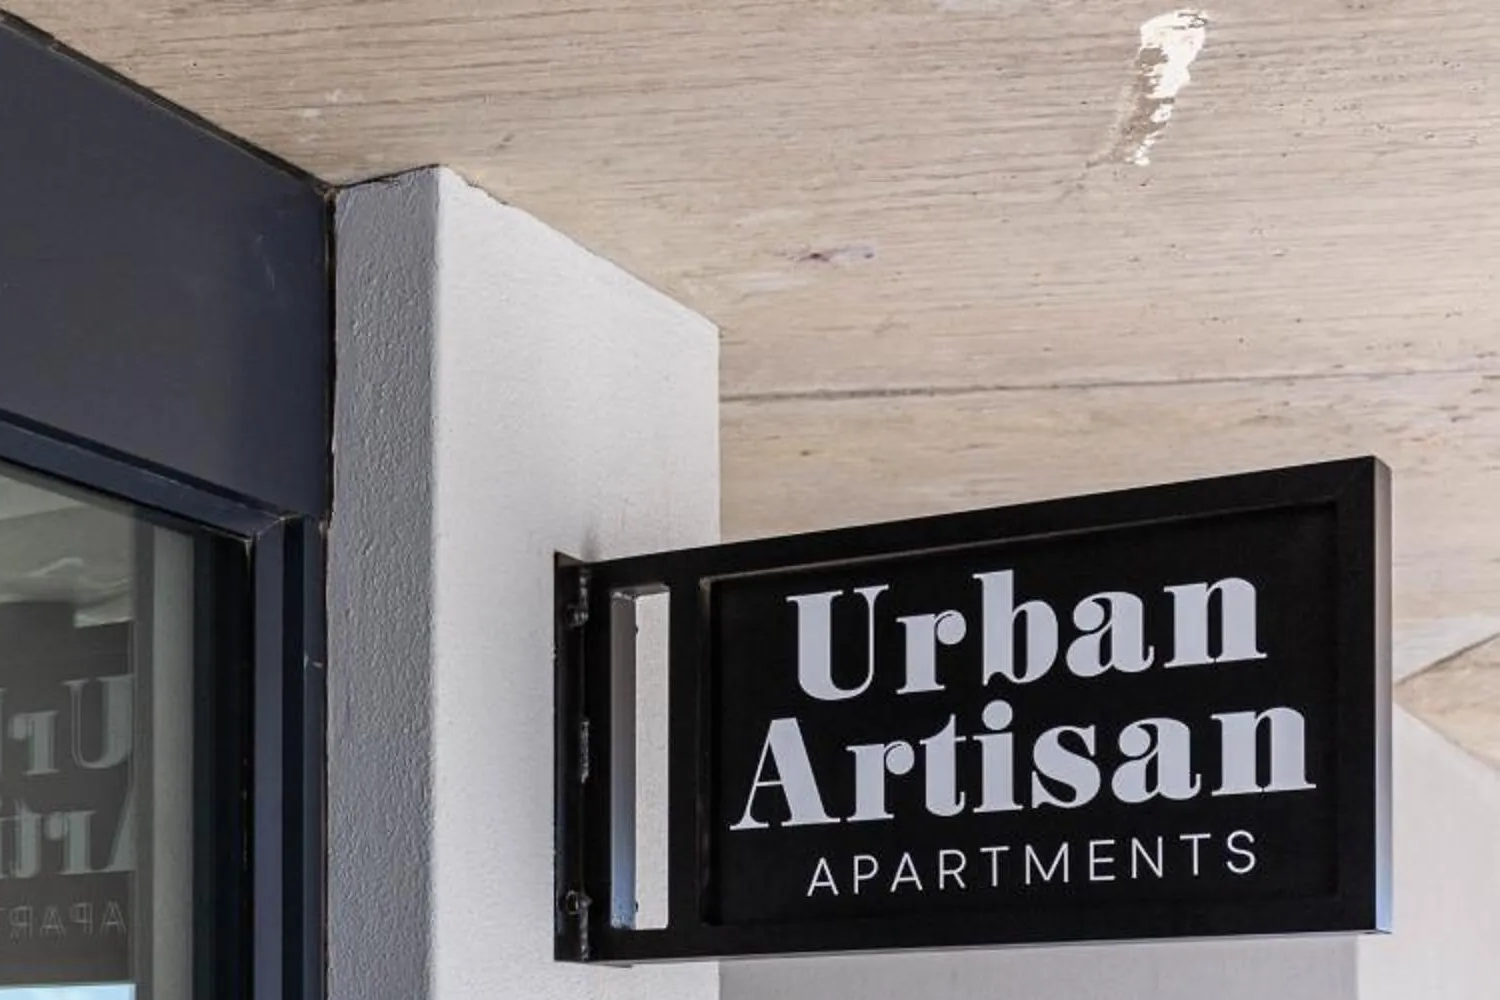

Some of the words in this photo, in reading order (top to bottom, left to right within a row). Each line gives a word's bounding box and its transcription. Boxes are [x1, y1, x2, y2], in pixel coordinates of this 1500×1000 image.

[786, 569, 1268, 701] Urban
[730, 699, 1317, 831] Artisan
[807, 829, 1257, 897] APARTMENTS
